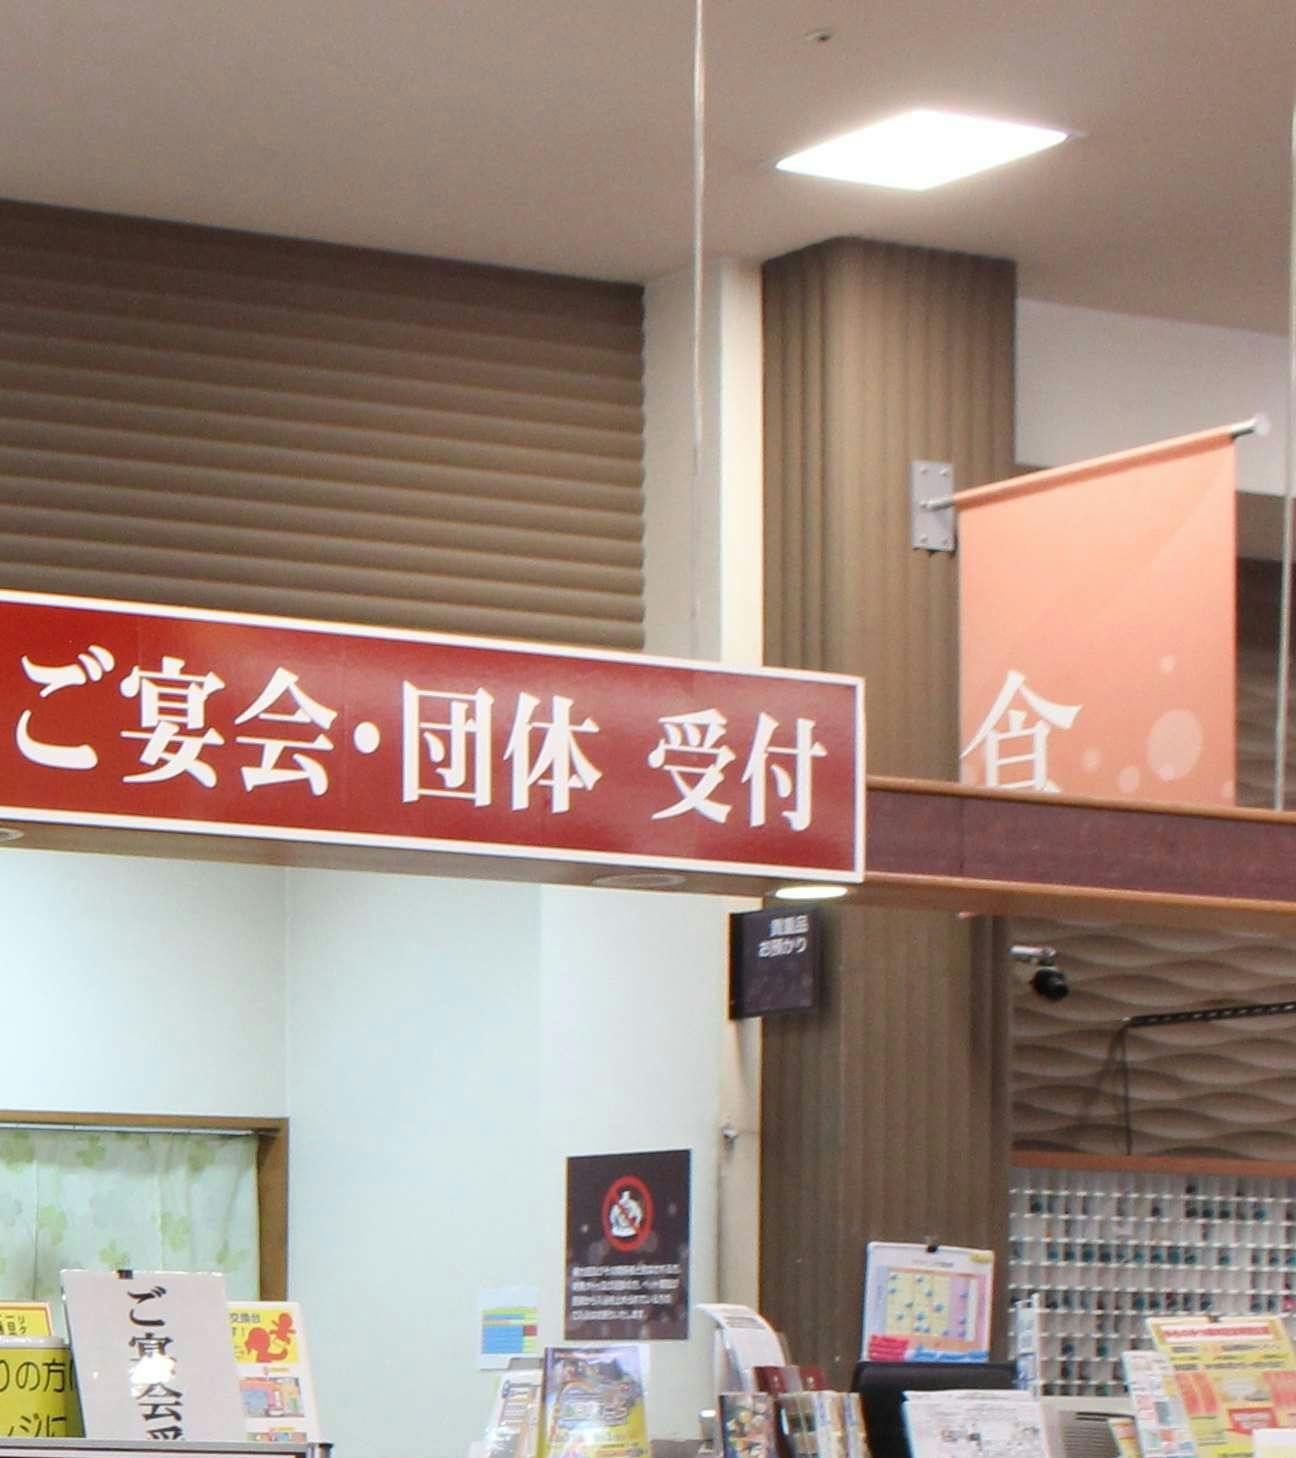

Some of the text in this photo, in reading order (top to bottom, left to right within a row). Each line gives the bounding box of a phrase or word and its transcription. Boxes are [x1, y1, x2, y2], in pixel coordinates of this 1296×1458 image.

[15, 642, 829, 832] ご宴会・団体 受付
